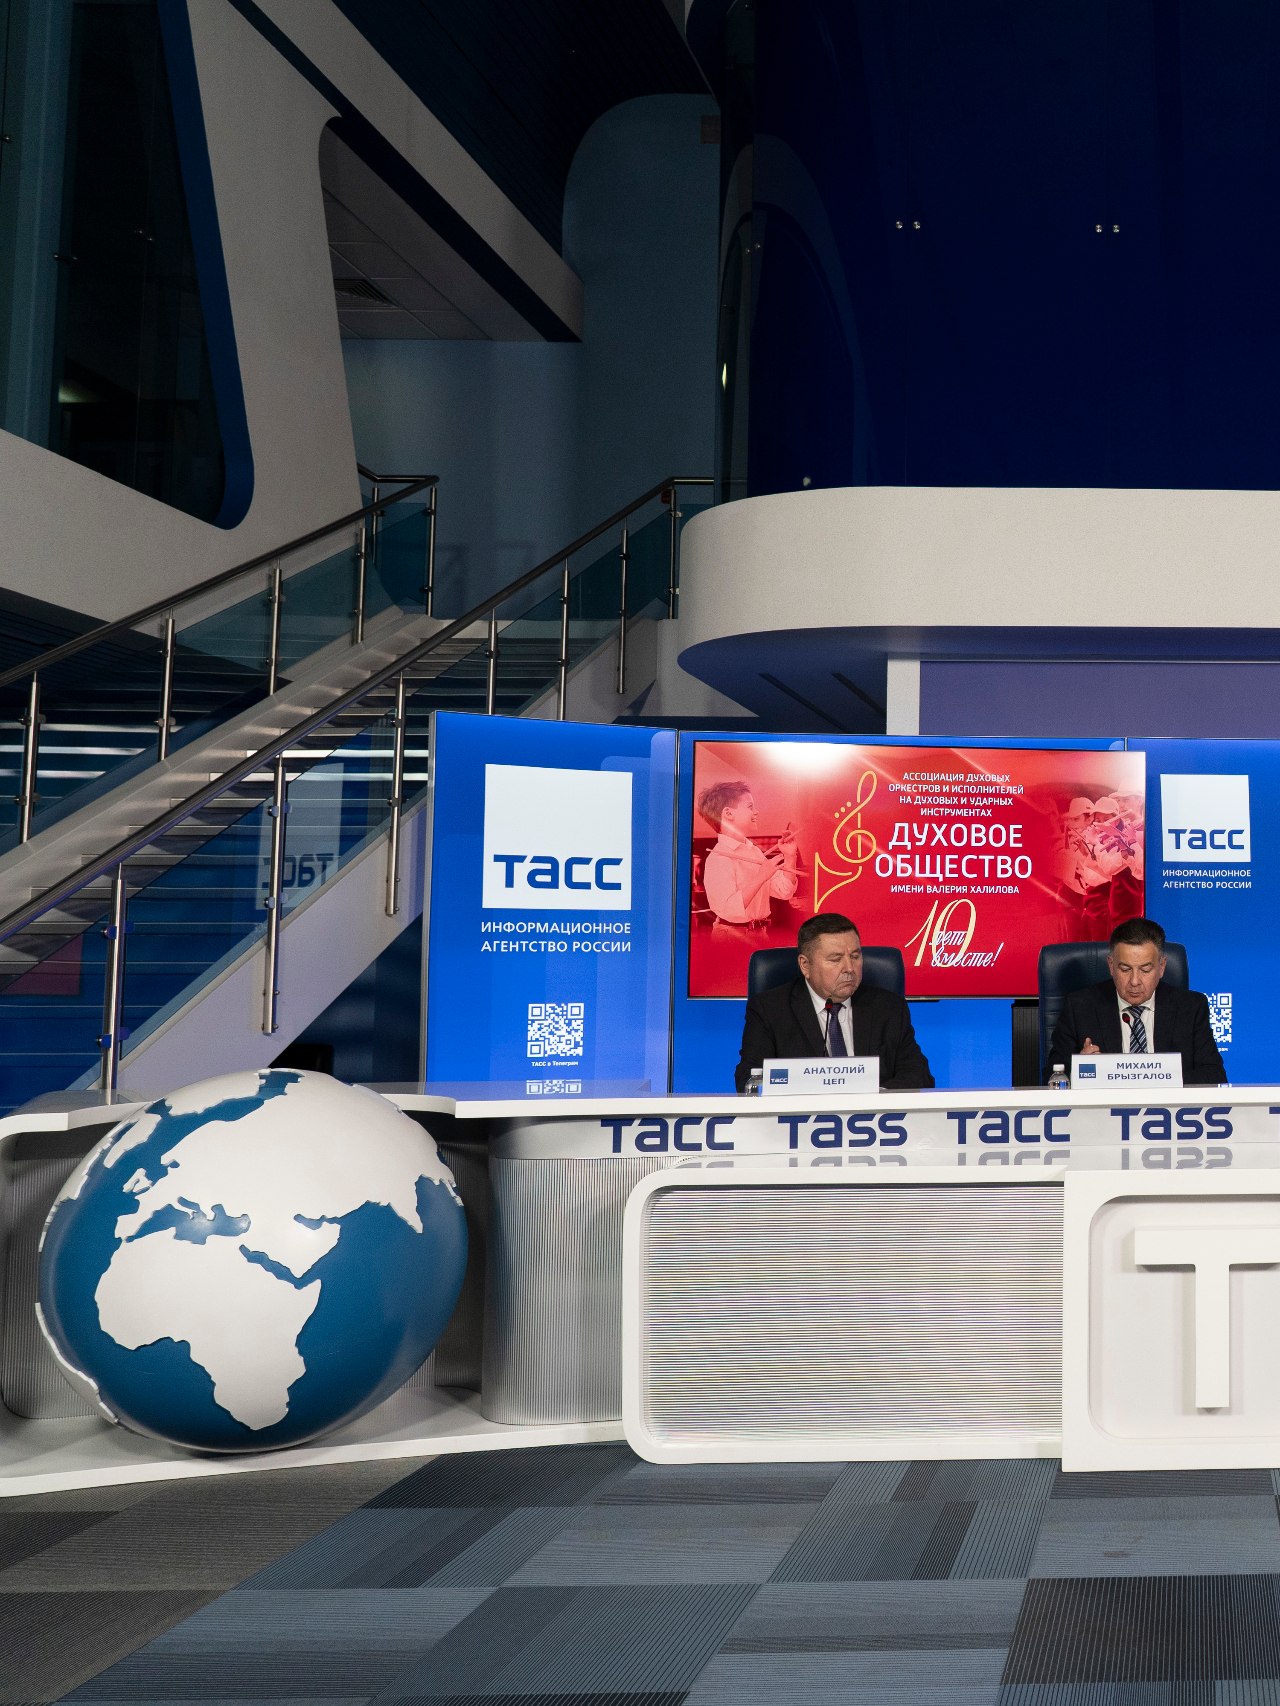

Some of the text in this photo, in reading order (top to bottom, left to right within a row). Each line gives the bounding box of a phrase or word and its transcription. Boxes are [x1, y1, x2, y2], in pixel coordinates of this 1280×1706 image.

[902, 772, 1010, 782] АССОЦИАЦИЯ ДУХОВЫХ
[888, 784, 1024, 794] ОРКЕСТРОВ И ИСПОЛНИТЕЛЕЙ
[899, 796, 1013, 806] НА ДУХОВЫХ И УДАРНЫХ
[920, 808, 992, 817] ИНСТРУМЕНТАХ
[888, 823, 1023, 850] ДУХОВОЕ
[875, 854, 1032, 882] ОБЩЕСТВО
[1162, 869, 1251, 878] ИНФОРМАЦИОННОЕ
[891, 885, 1019, 894] ИМЕНИ ВАЛЕРИЯ ХАЛИЛОВА
[1163, 881, 1252, 889] АГЕНТСТВО РОССИИ
[481, 921, 631, 935] ИНФОРМАЦИОННОЕ
[904, 898, 976, 967] 10
[480, 940, 631, 953] АГЕНТСТВО РОССИИ
[803, 1064, 865, 1075] АНАТОЛИЙ
